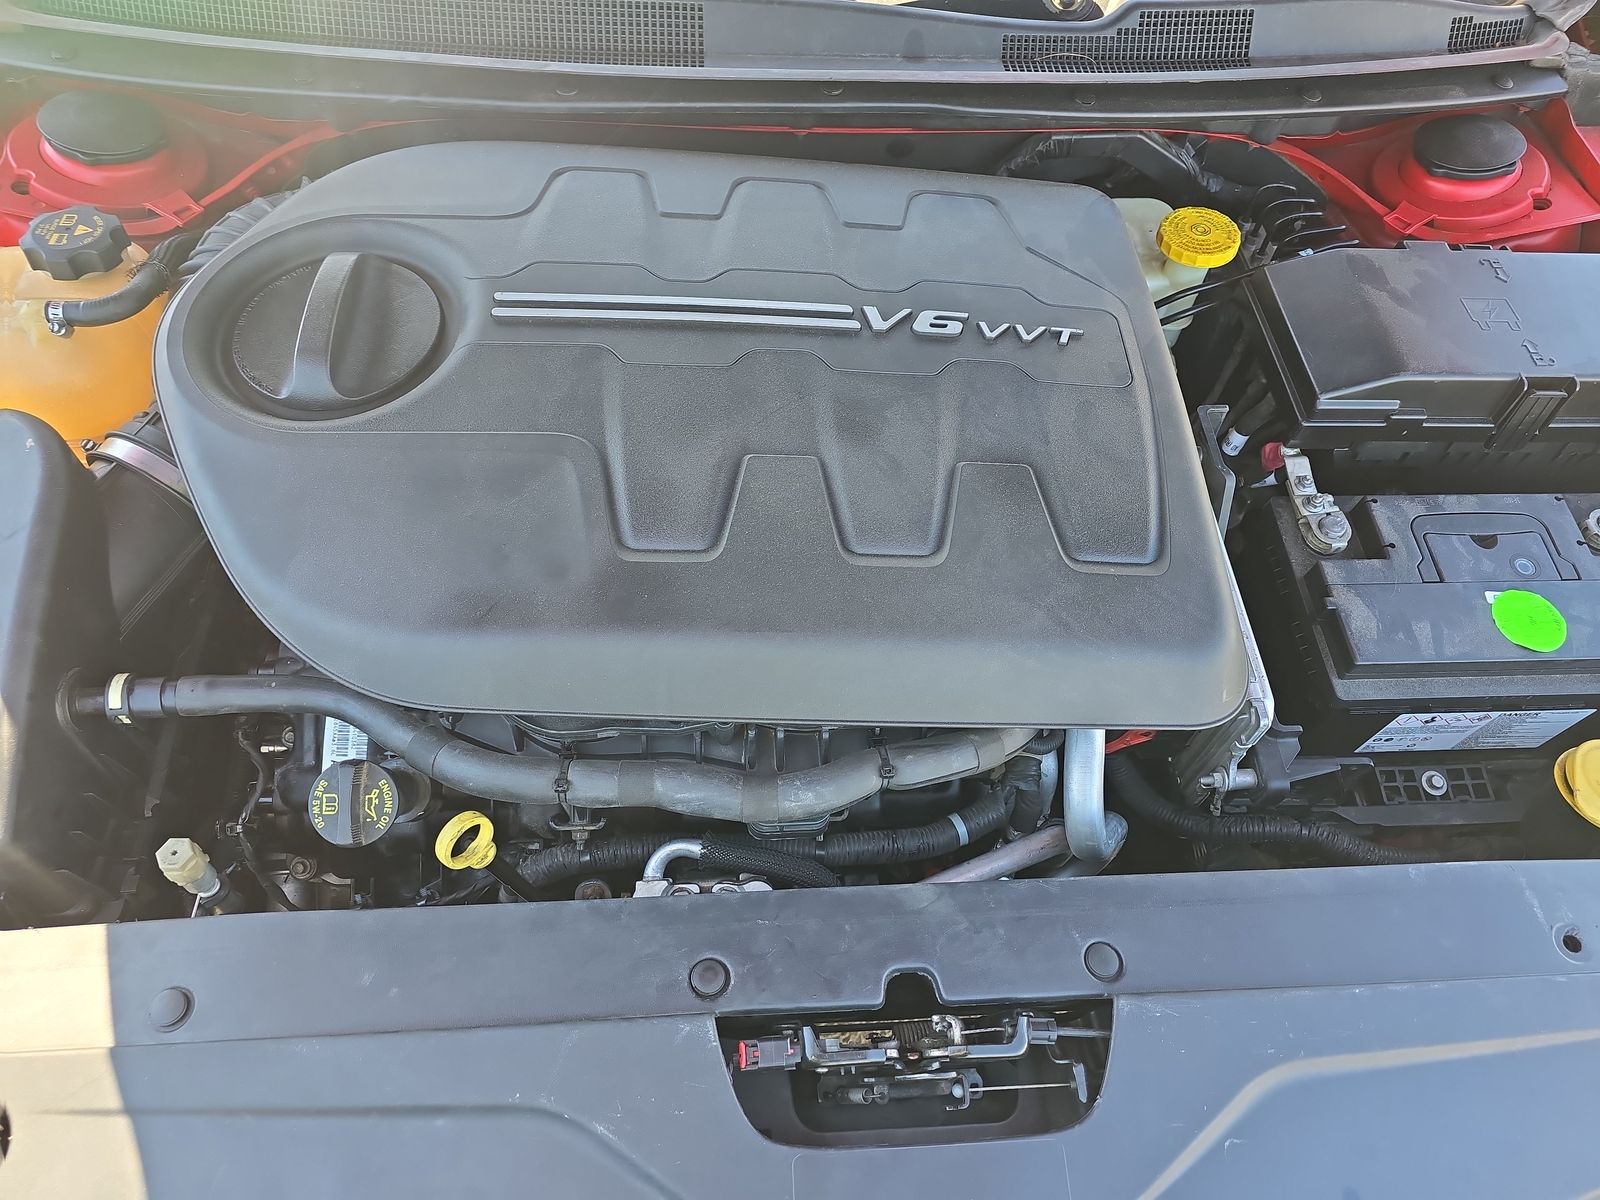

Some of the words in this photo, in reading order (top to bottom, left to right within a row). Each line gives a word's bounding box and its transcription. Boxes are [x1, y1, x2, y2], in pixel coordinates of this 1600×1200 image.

[861, 305, 970, 338] V6
[976, 321, 1084, 346] VVT
[313, 779, 328, 798] SAE
[378, 778, 393, 814] ENGINE
[311, 799, 325, 829] 5W-20
[375, 815, 390, 831] OIL
